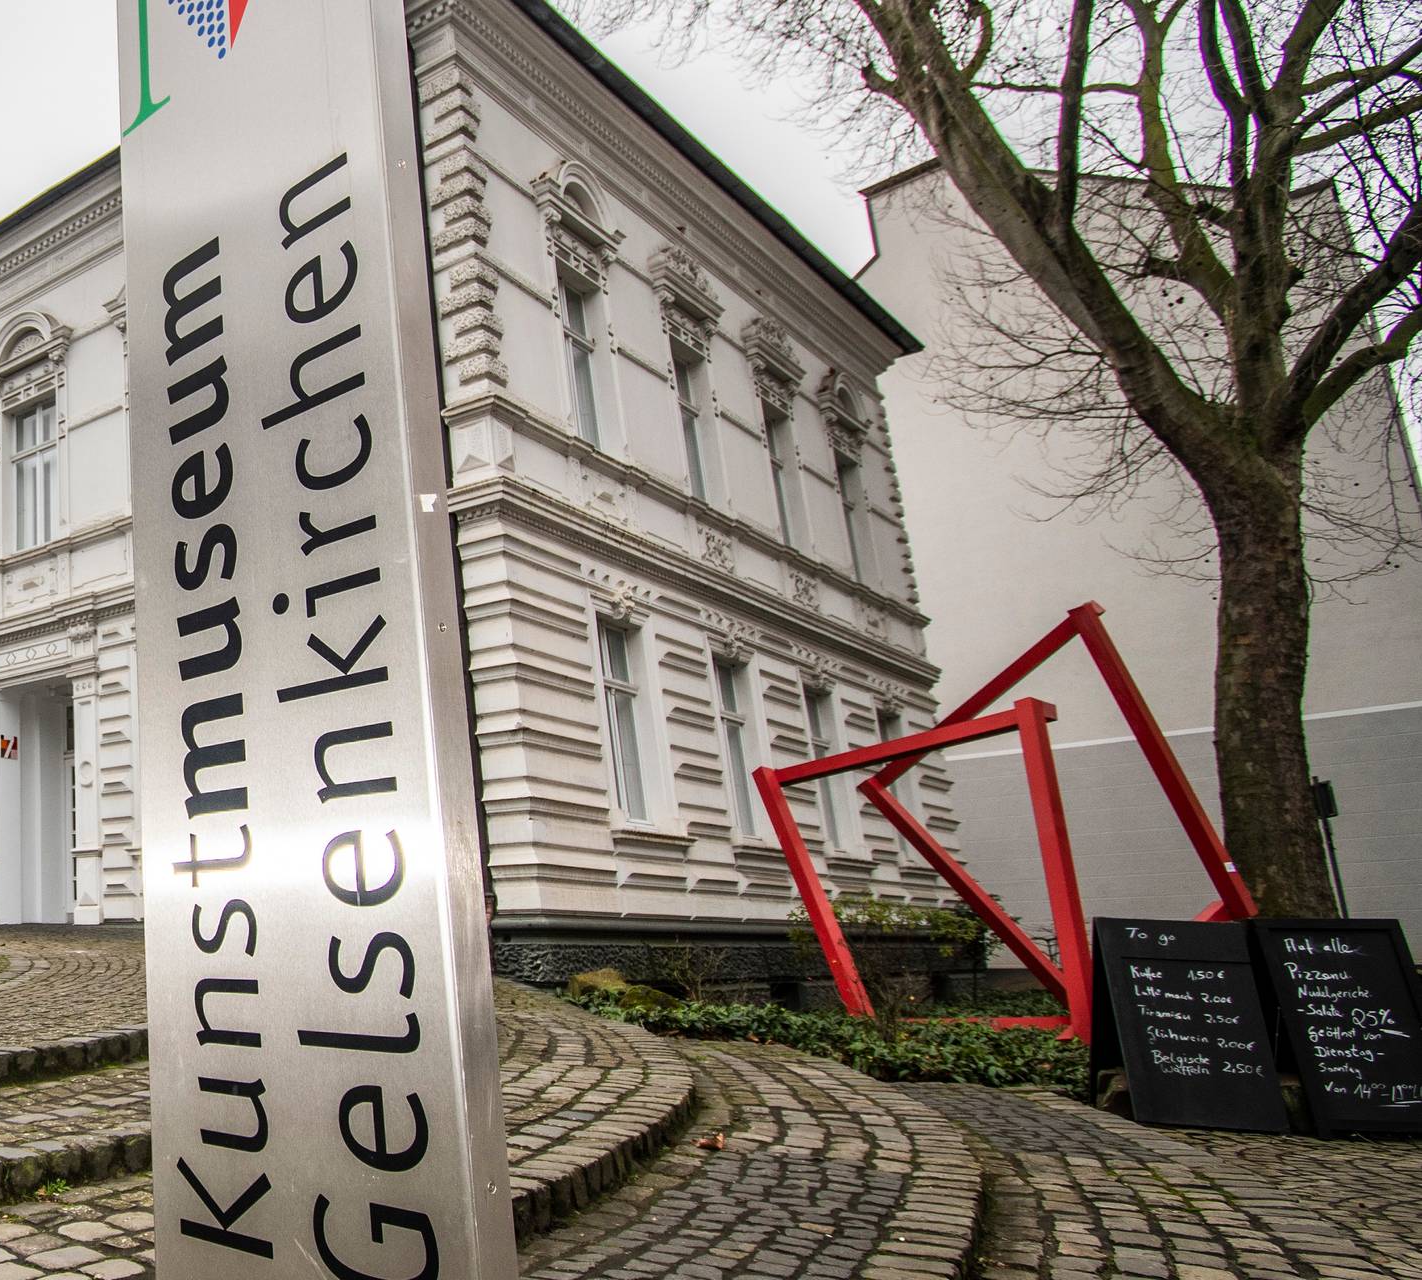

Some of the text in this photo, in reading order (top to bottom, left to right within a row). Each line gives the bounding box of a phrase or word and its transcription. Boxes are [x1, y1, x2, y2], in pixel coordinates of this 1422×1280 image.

[261, 151, 440, 1280] Gelsenkirchen
[162, 236, 274, 1260] Kunstmuseum
[1124, 927, 1177, 946] To go
[1323, 937, 1354, 954] alle
[1137, 1004, 1191, 1021] Tiramisu
[1351, 1007, 1395, 1029] 25%
[1150, 1049, 1211, 1068] Belgische
